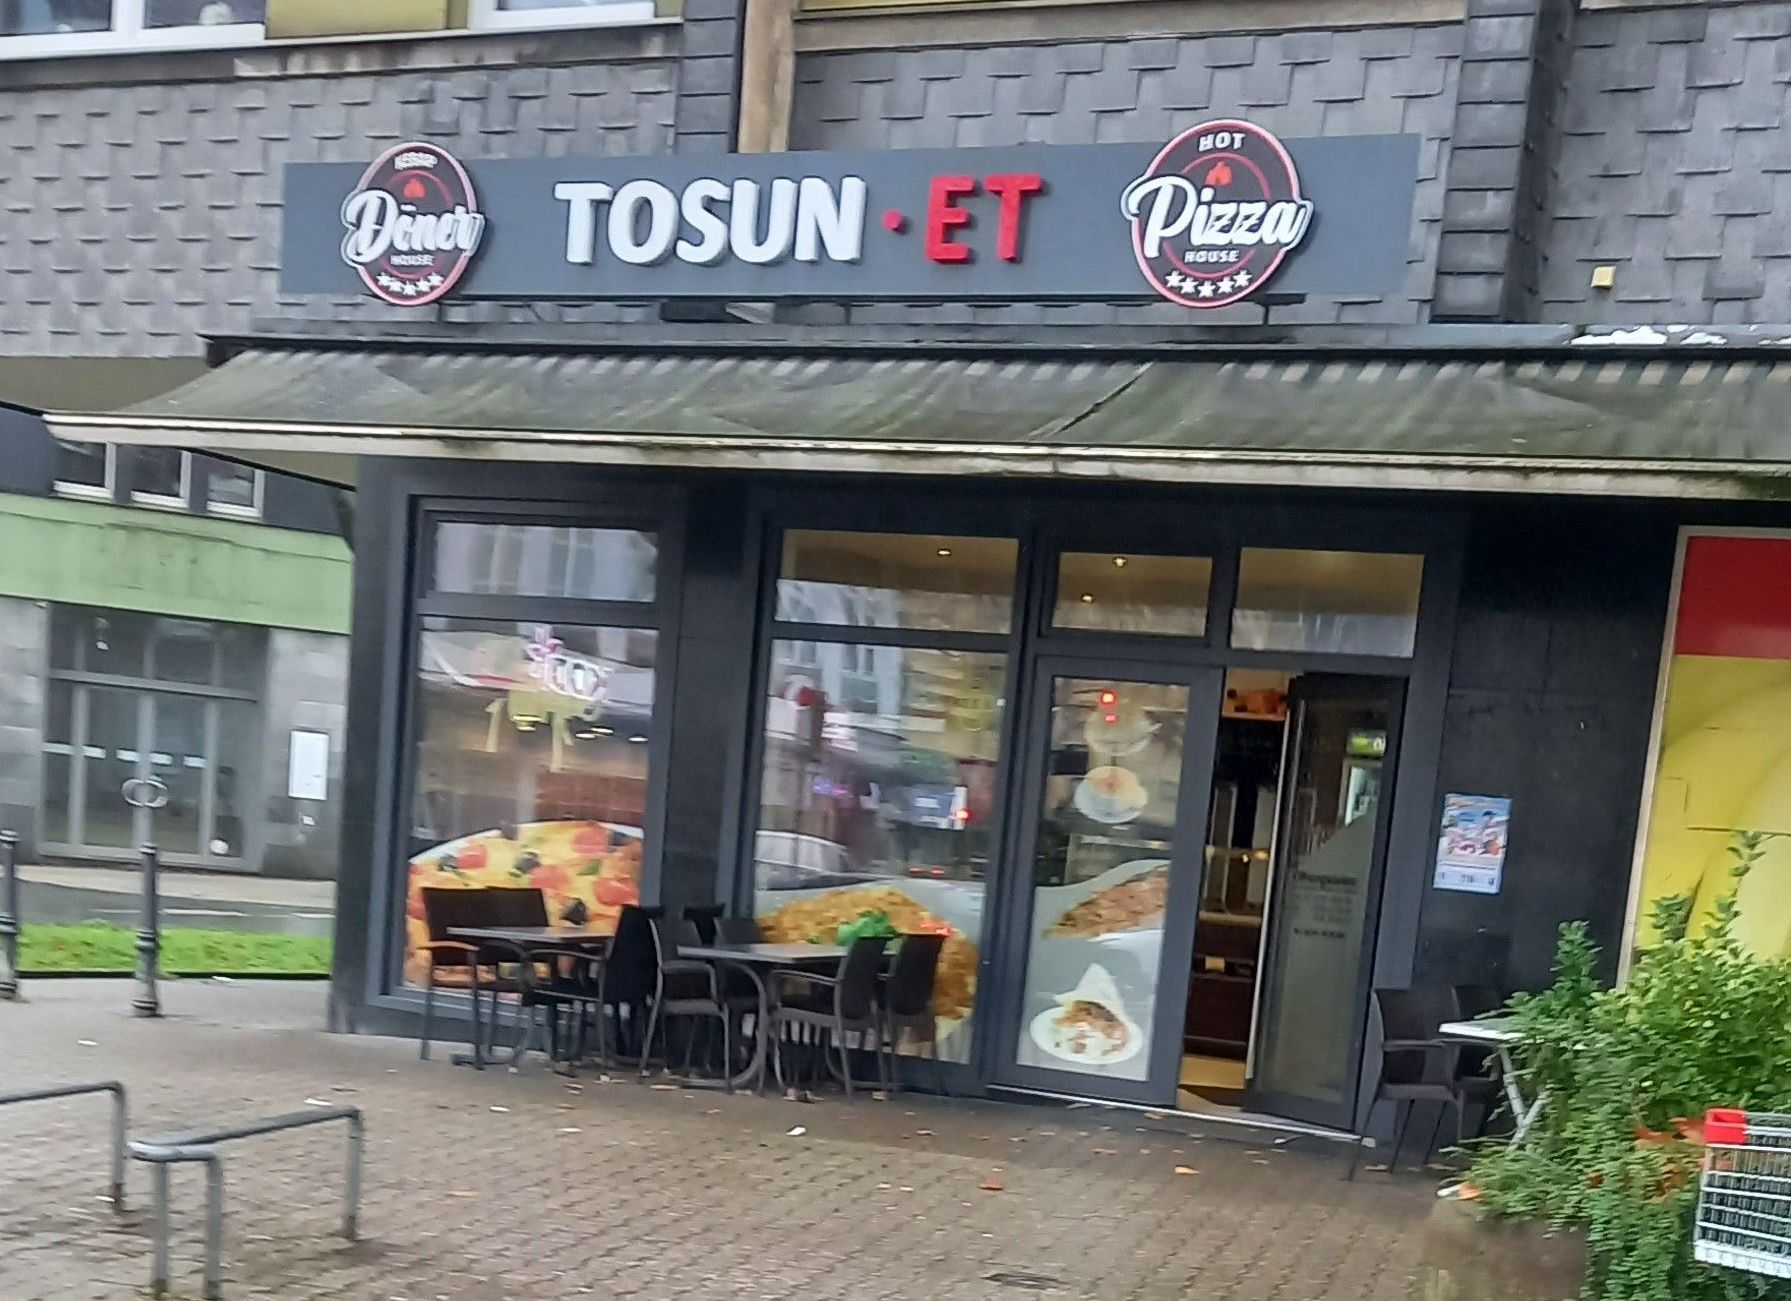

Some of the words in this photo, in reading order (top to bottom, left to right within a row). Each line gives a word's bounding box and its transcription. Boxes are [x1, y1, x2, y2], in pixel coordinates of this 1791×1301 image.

[1197, 131, 1246, 152] HOT
[553, 176, 867, 265] TOSUN
[924, 172, 1044, 264] ET
[1125, 175, 1309, 259] Pizza
[1183, 248, 1240, 263] HOUSE
